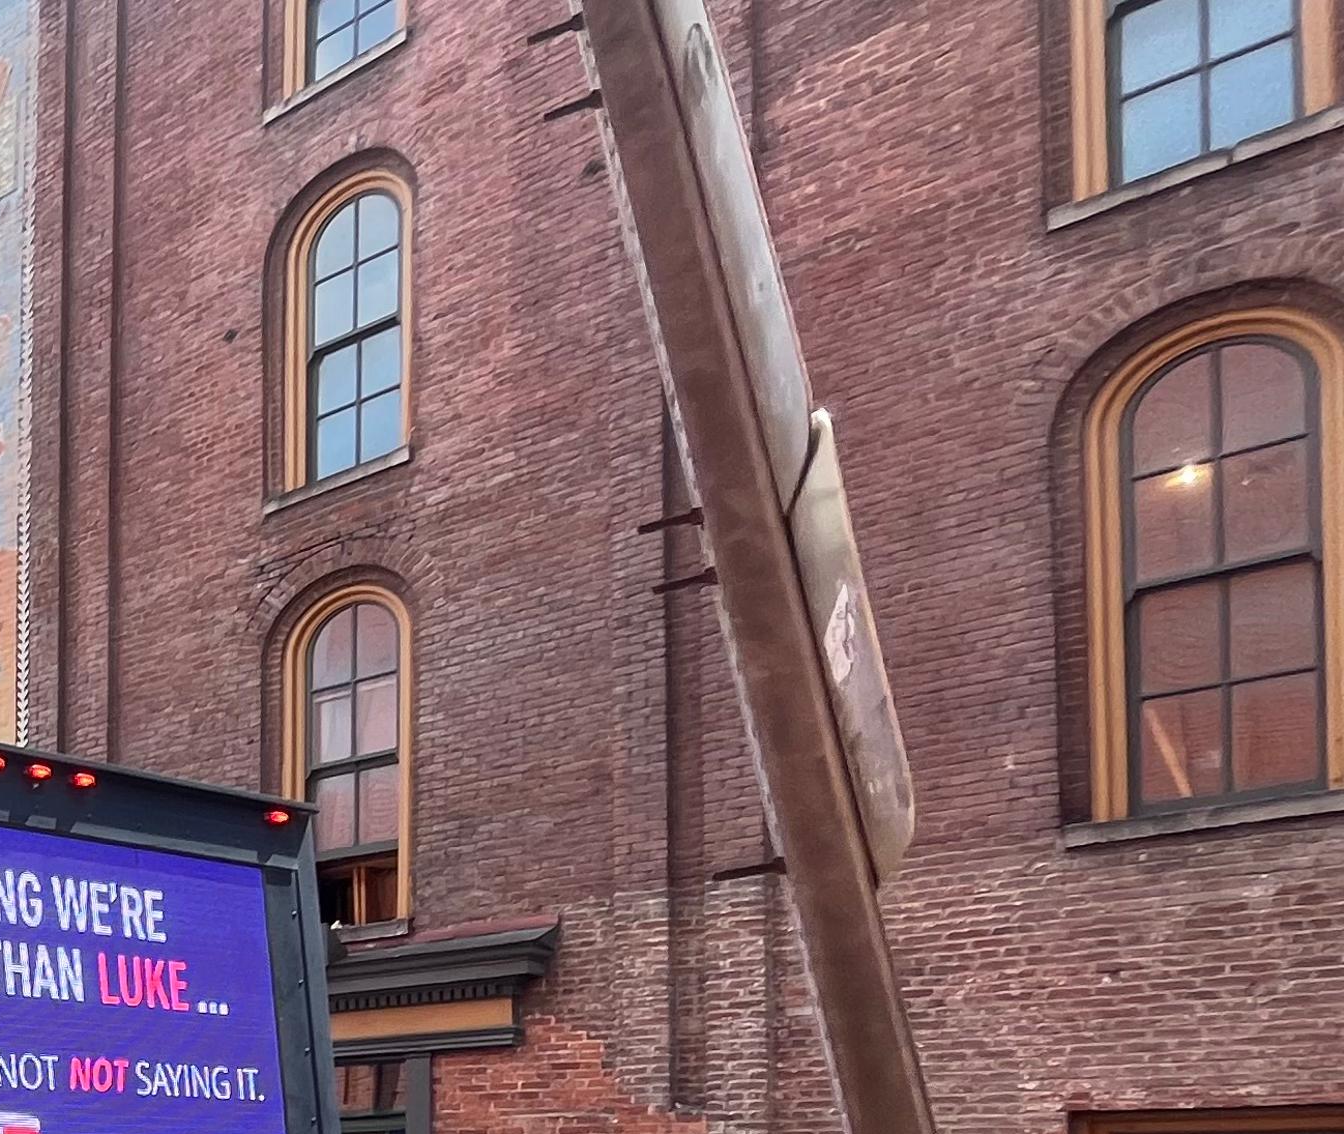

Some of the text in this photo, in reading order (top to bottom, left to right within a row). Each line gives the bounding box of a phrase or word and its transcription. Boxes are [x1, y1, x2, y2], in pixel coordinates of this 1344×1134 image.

[51, 875, 167, 943] WE'RE
[69, 1055, 129, 1094] NOT
[135, 1059, 232, 1101] SAYING
[236, 1067, 265, 1102] IT.
